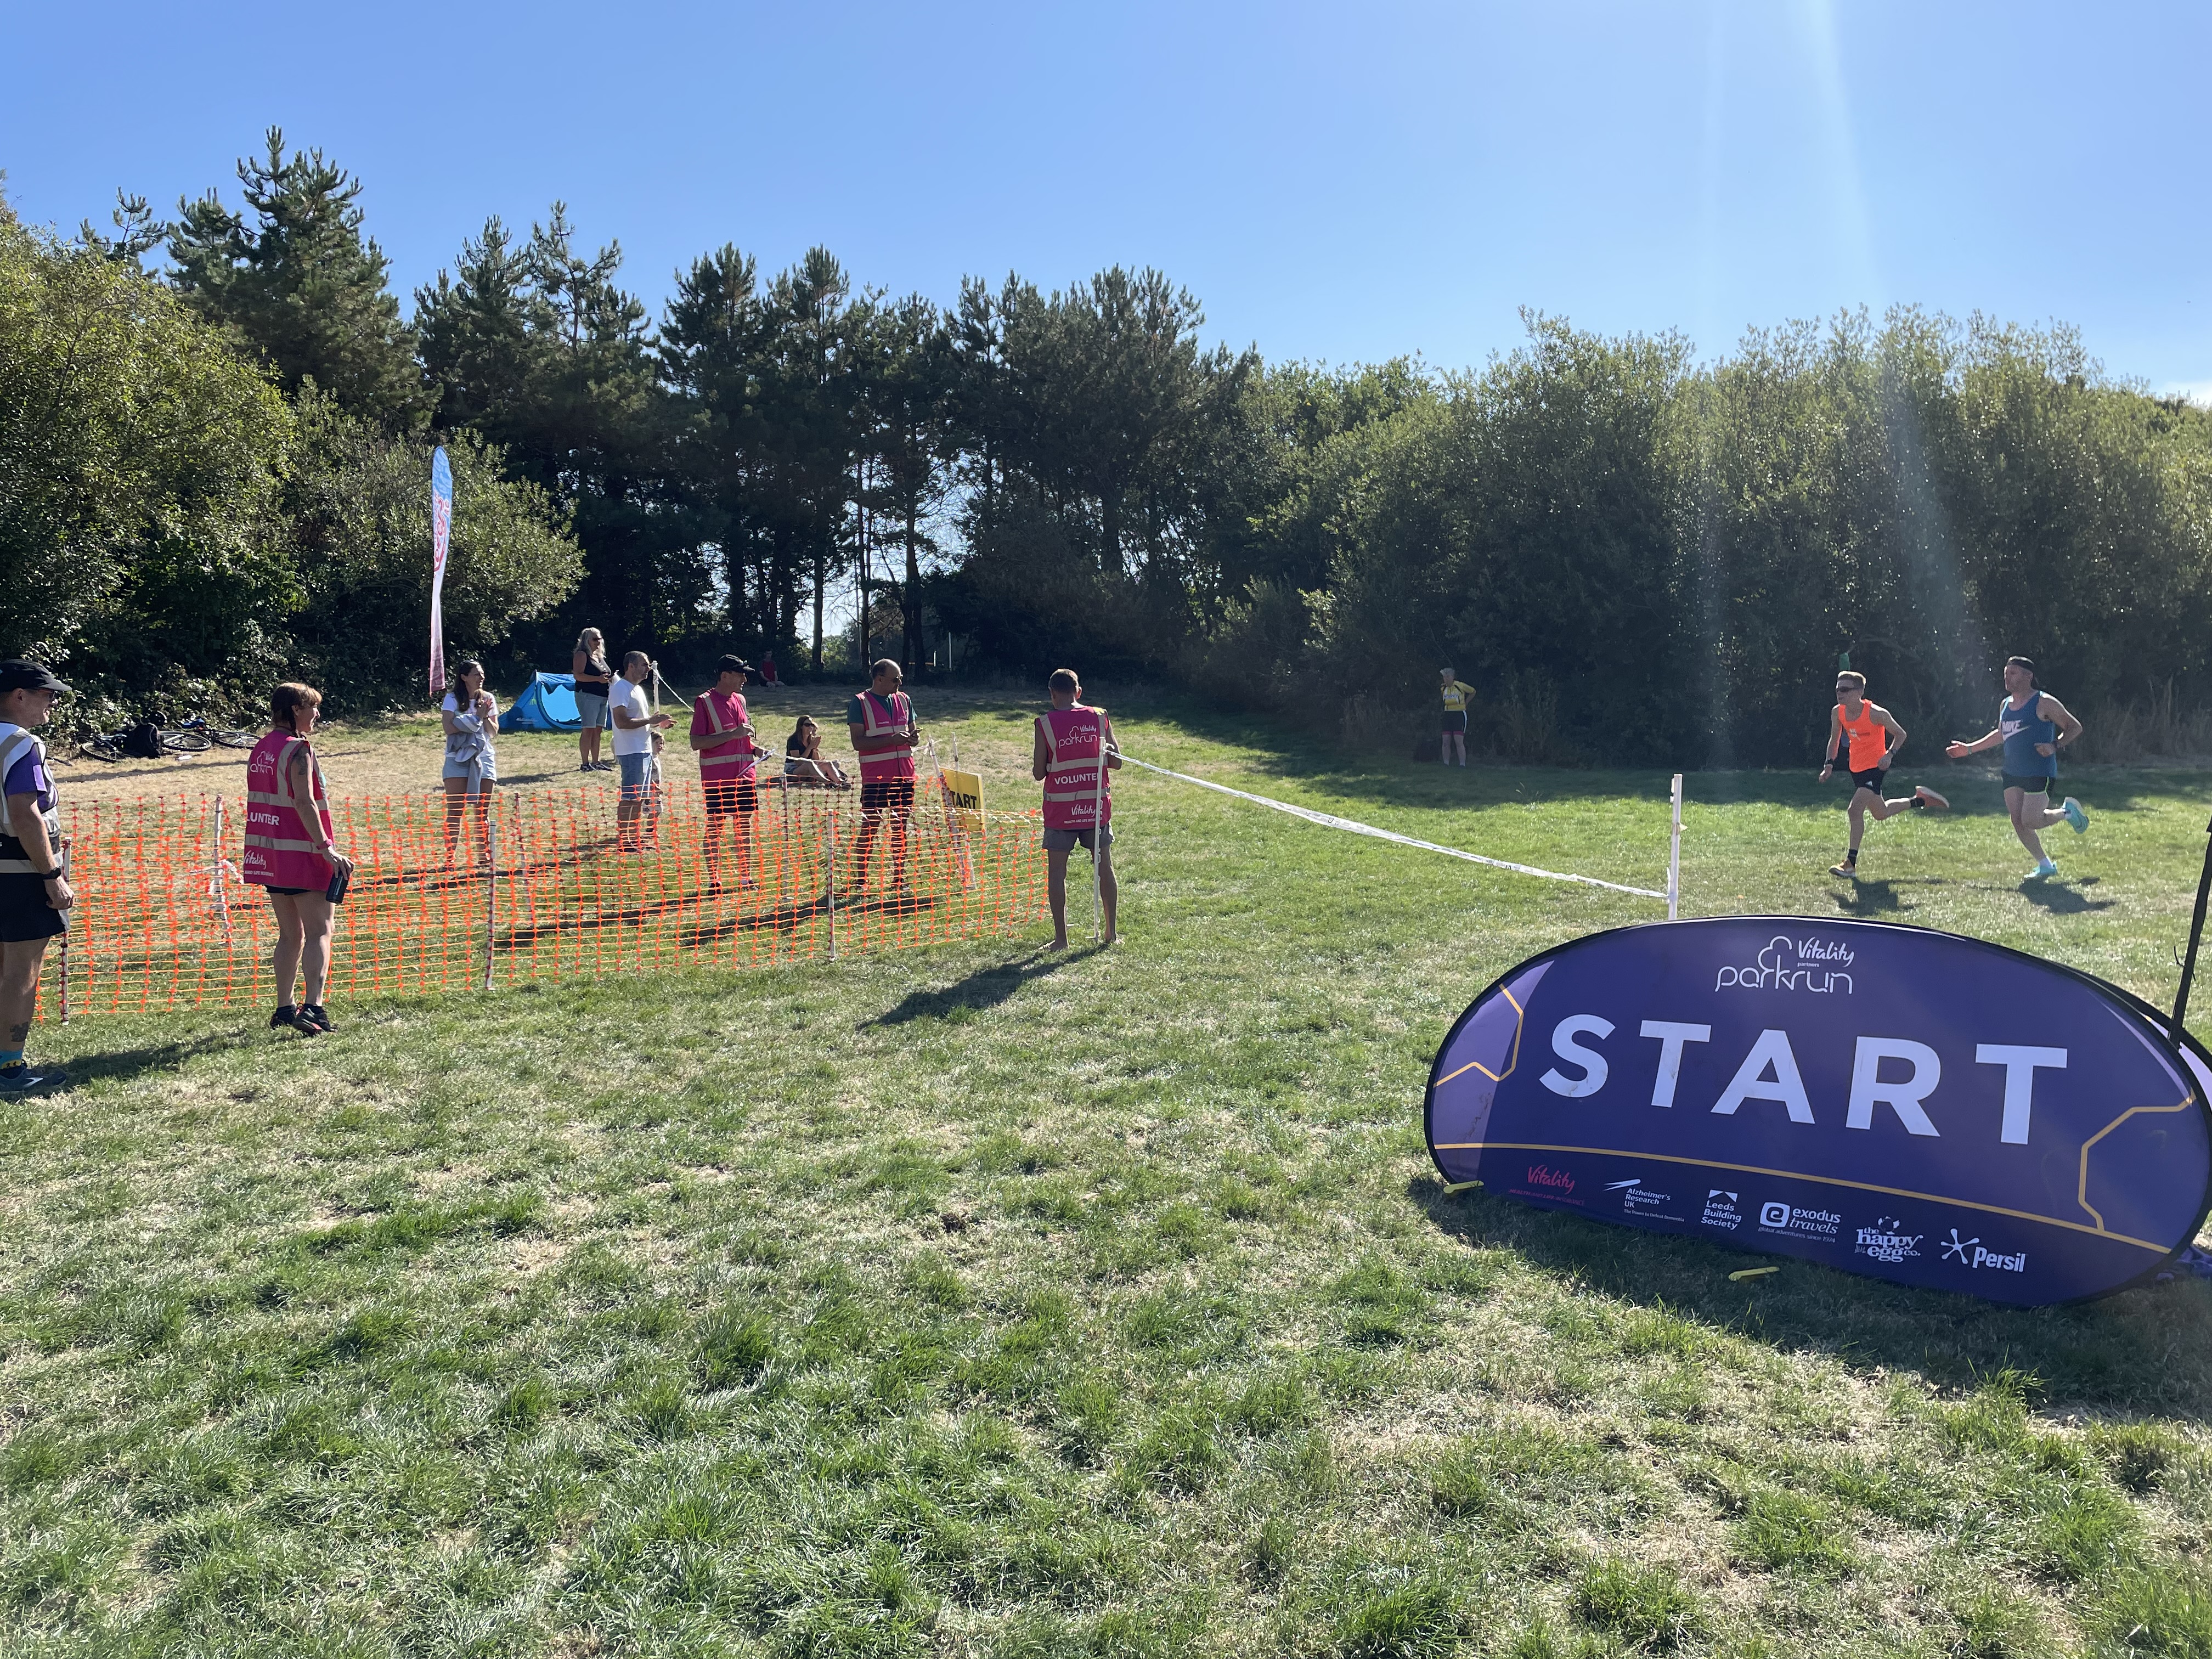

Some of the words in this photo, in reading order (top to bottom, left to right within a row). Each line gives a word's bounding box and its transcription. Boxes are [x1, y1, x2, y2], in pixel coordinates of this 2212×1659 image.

[1080, 724, 1097, 733] Vitality
[1058, 731, 1097, 749] parkrun
[1054, 772, 1098, 785] VOLUNTE
[950, 791, 977, 810] TART
[1071, 804, 1096, 817] Vitality
[1797, 936, 1855, 968] Vitality
[1715, 951, 1853, 995] parkrun
[1539, 1014, 2068, 1145] START
[1527, 1164, 1576, 1194] Vitality
[1625, 1194, 1660, 1205] Research
[1627, 1188, 1671, 1201] Alzheimer's
[1624, 1200, 1635, 1208] UK
[1706, 1200, 1735, 1211] Leeds
[1703, 1208, 1742, 1223] Building
[1792, 1208, 1841, 1223] exodus
[1701, 1216, 1738, 1231] Society
[1789, 1217, 1838, 1234] travels
[1864, 1226, 1880, 1234] the
[1775, 1229, 1805, 1238] adventures
[1855, 1228, 1924, 1250] happy
[1867, 1246, 1904, 1262] egg
[1972, 1246, 2027, 1273] Persil
